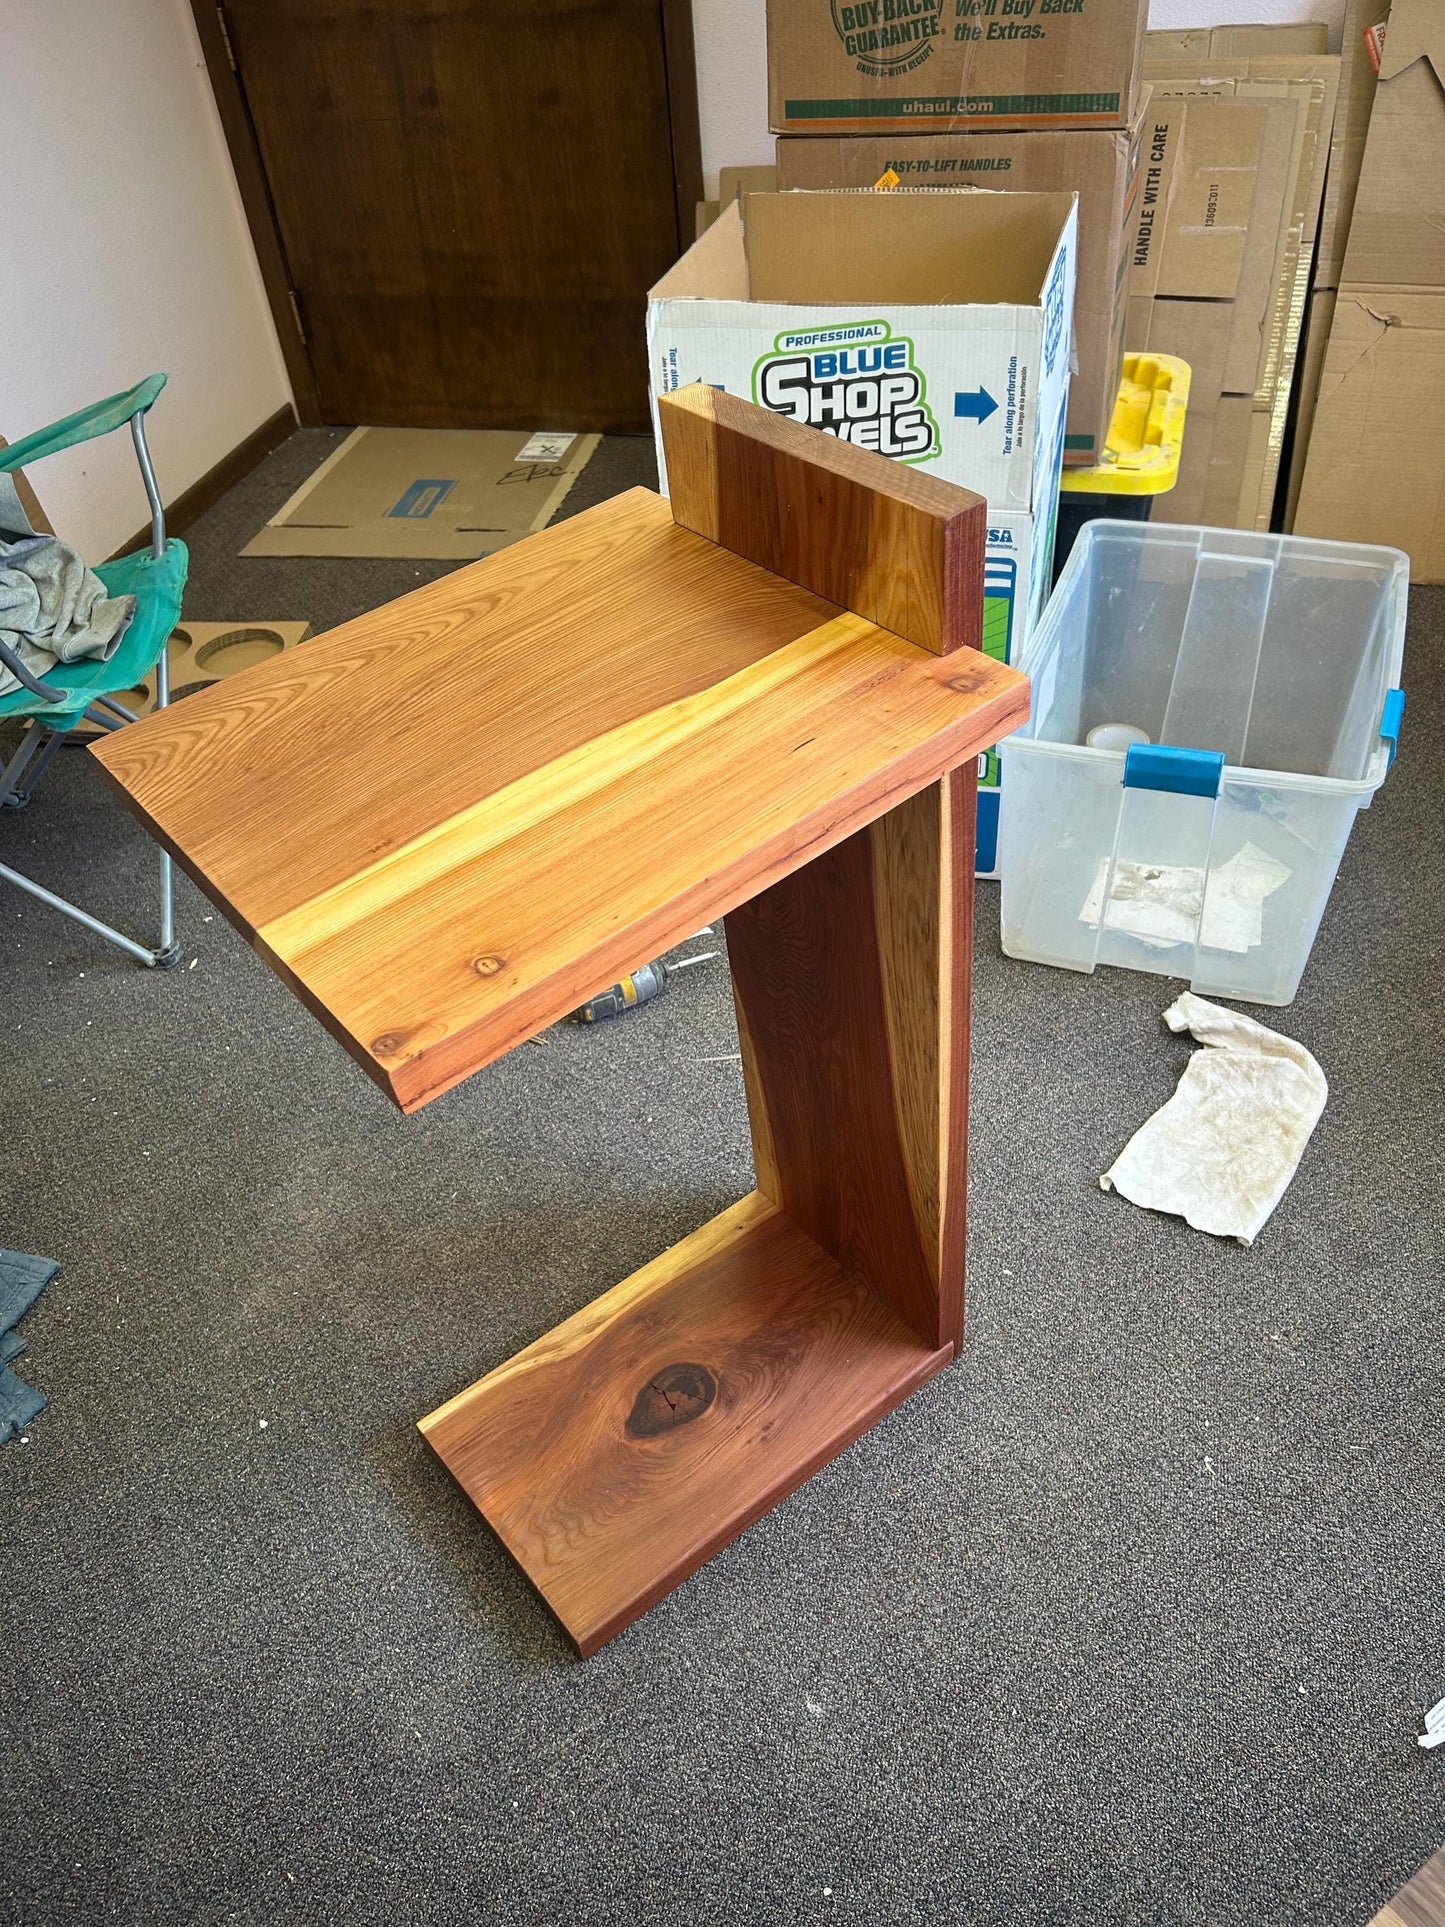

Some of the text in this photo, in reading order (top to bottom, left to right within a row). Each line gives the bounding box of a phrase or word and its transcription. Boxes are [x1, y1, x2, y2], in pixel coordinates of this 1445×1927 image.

[1001, 0, 1036, 19] Buy
[1040, 0, 1084, 14] Back
[845, 15, 940, 56] GUARANTEE
[953, 21, 1046, 41] the Extras.
[902, 100, 994, 113] uhaul.com
[884, 157, 1013, 173] EASY-TO-LIFT HANDLES
[1133, 124, 1168, 266] HANDLE WITH CARE
[785, 326, 882, 348] PROFESSIONAL
[669, 347, 678, 367] Tear
[814, 344, 906, 379] BLUE
[763, 360, 917, 425] SHOP
[1003, 356, 1018, 455] Tear along perforation
[986, 529, 1013, 543] SA
